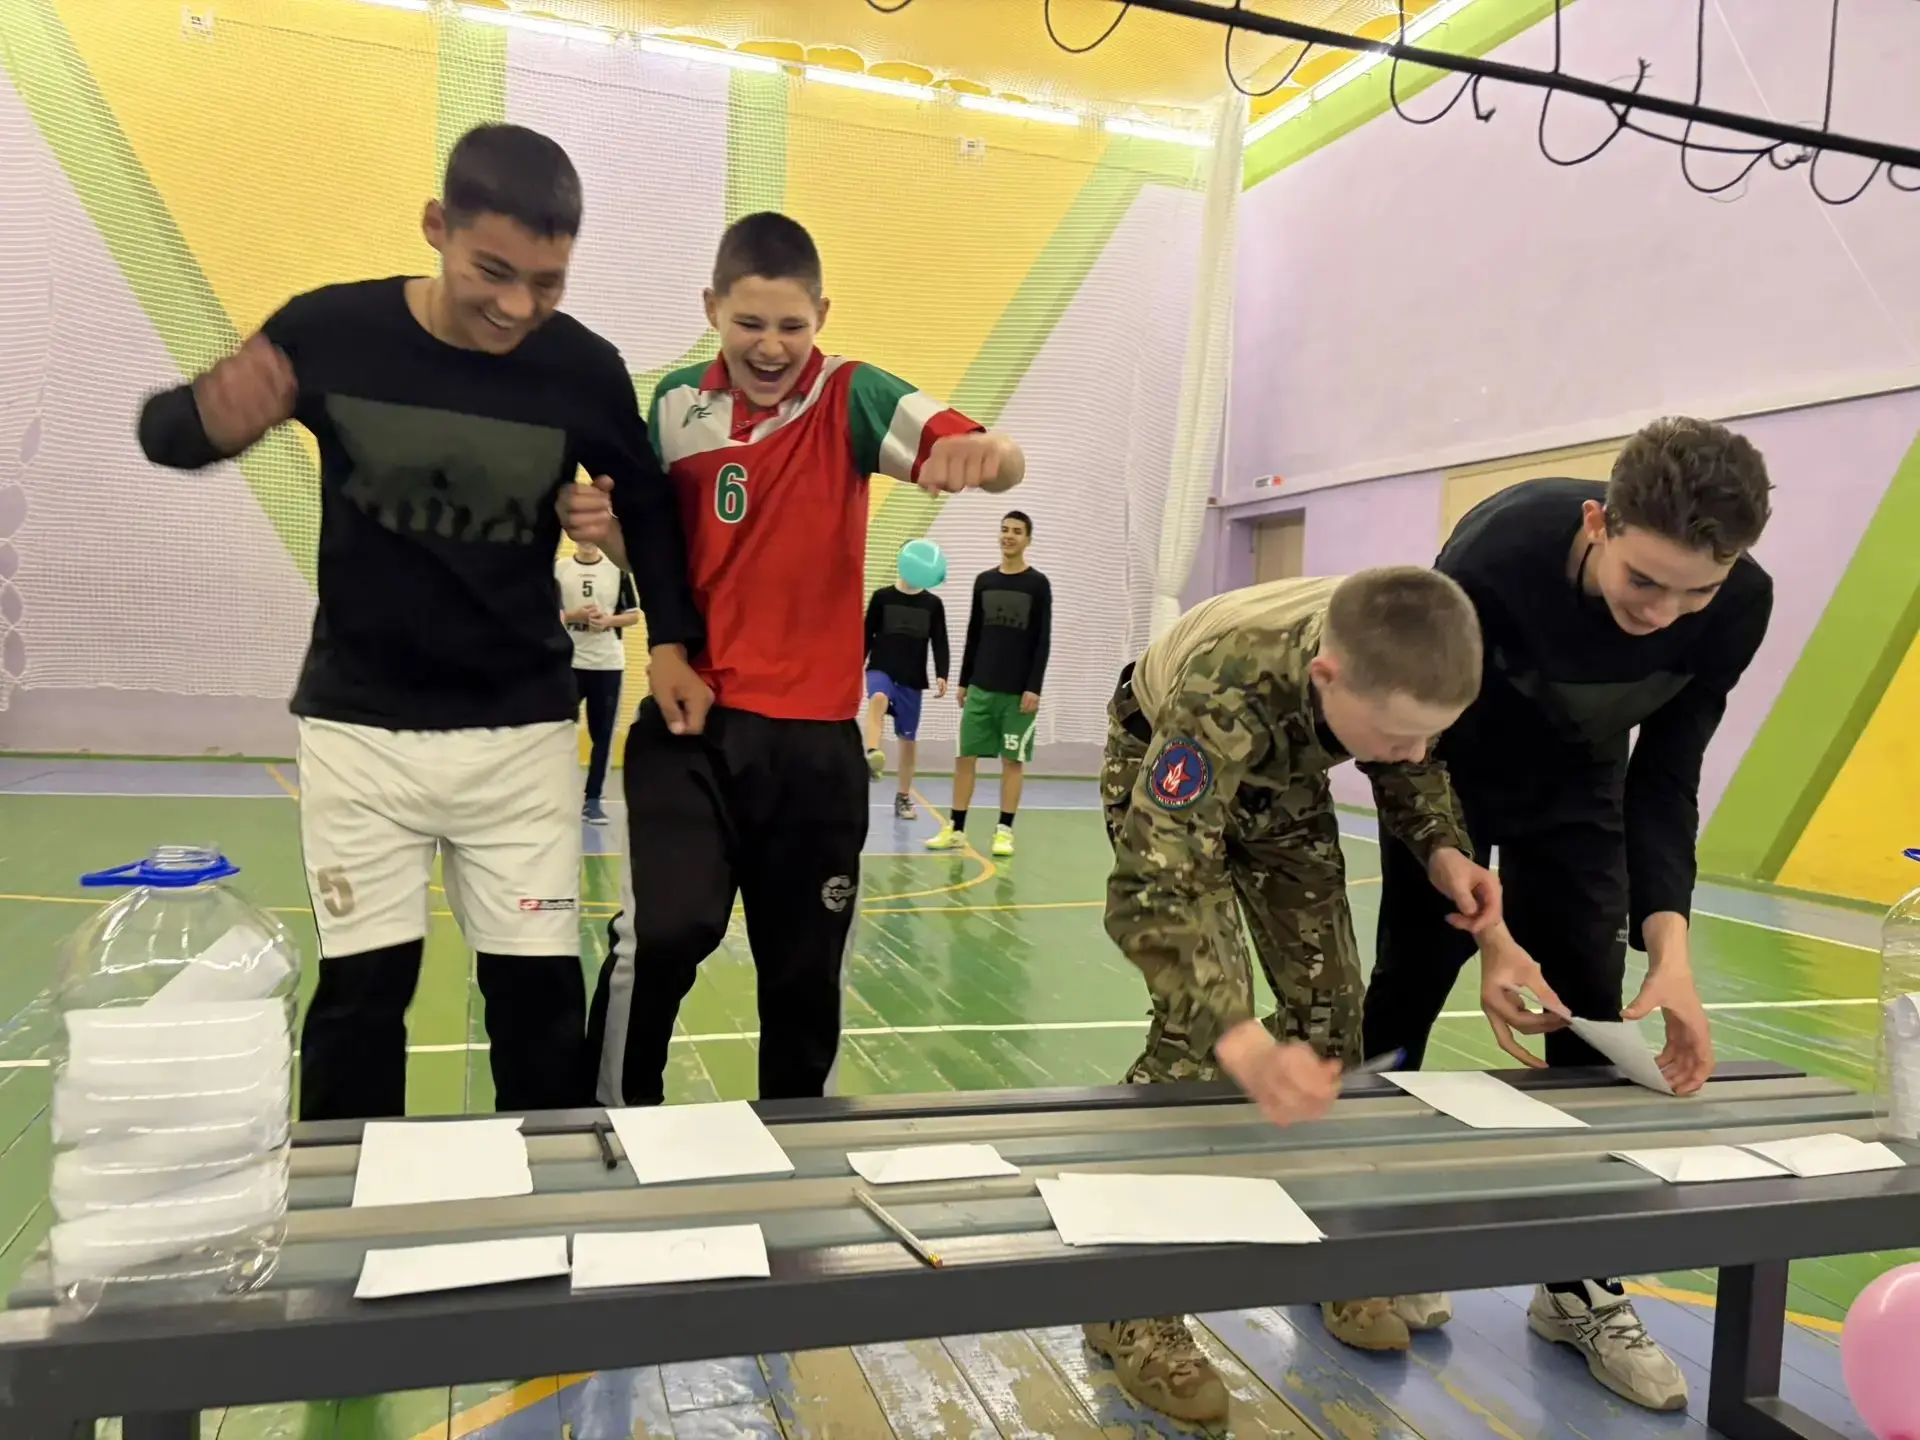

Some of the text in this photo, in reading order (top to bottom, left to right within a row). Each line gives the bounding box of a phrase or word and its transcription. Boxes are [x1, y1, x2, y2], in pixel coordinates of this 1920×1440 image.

[714, 462, 748, 523] 6
[582, 580, 593, 597] 5
[1003, 733, 1019, 751] 15
[318, 867, 354, 918] 5
